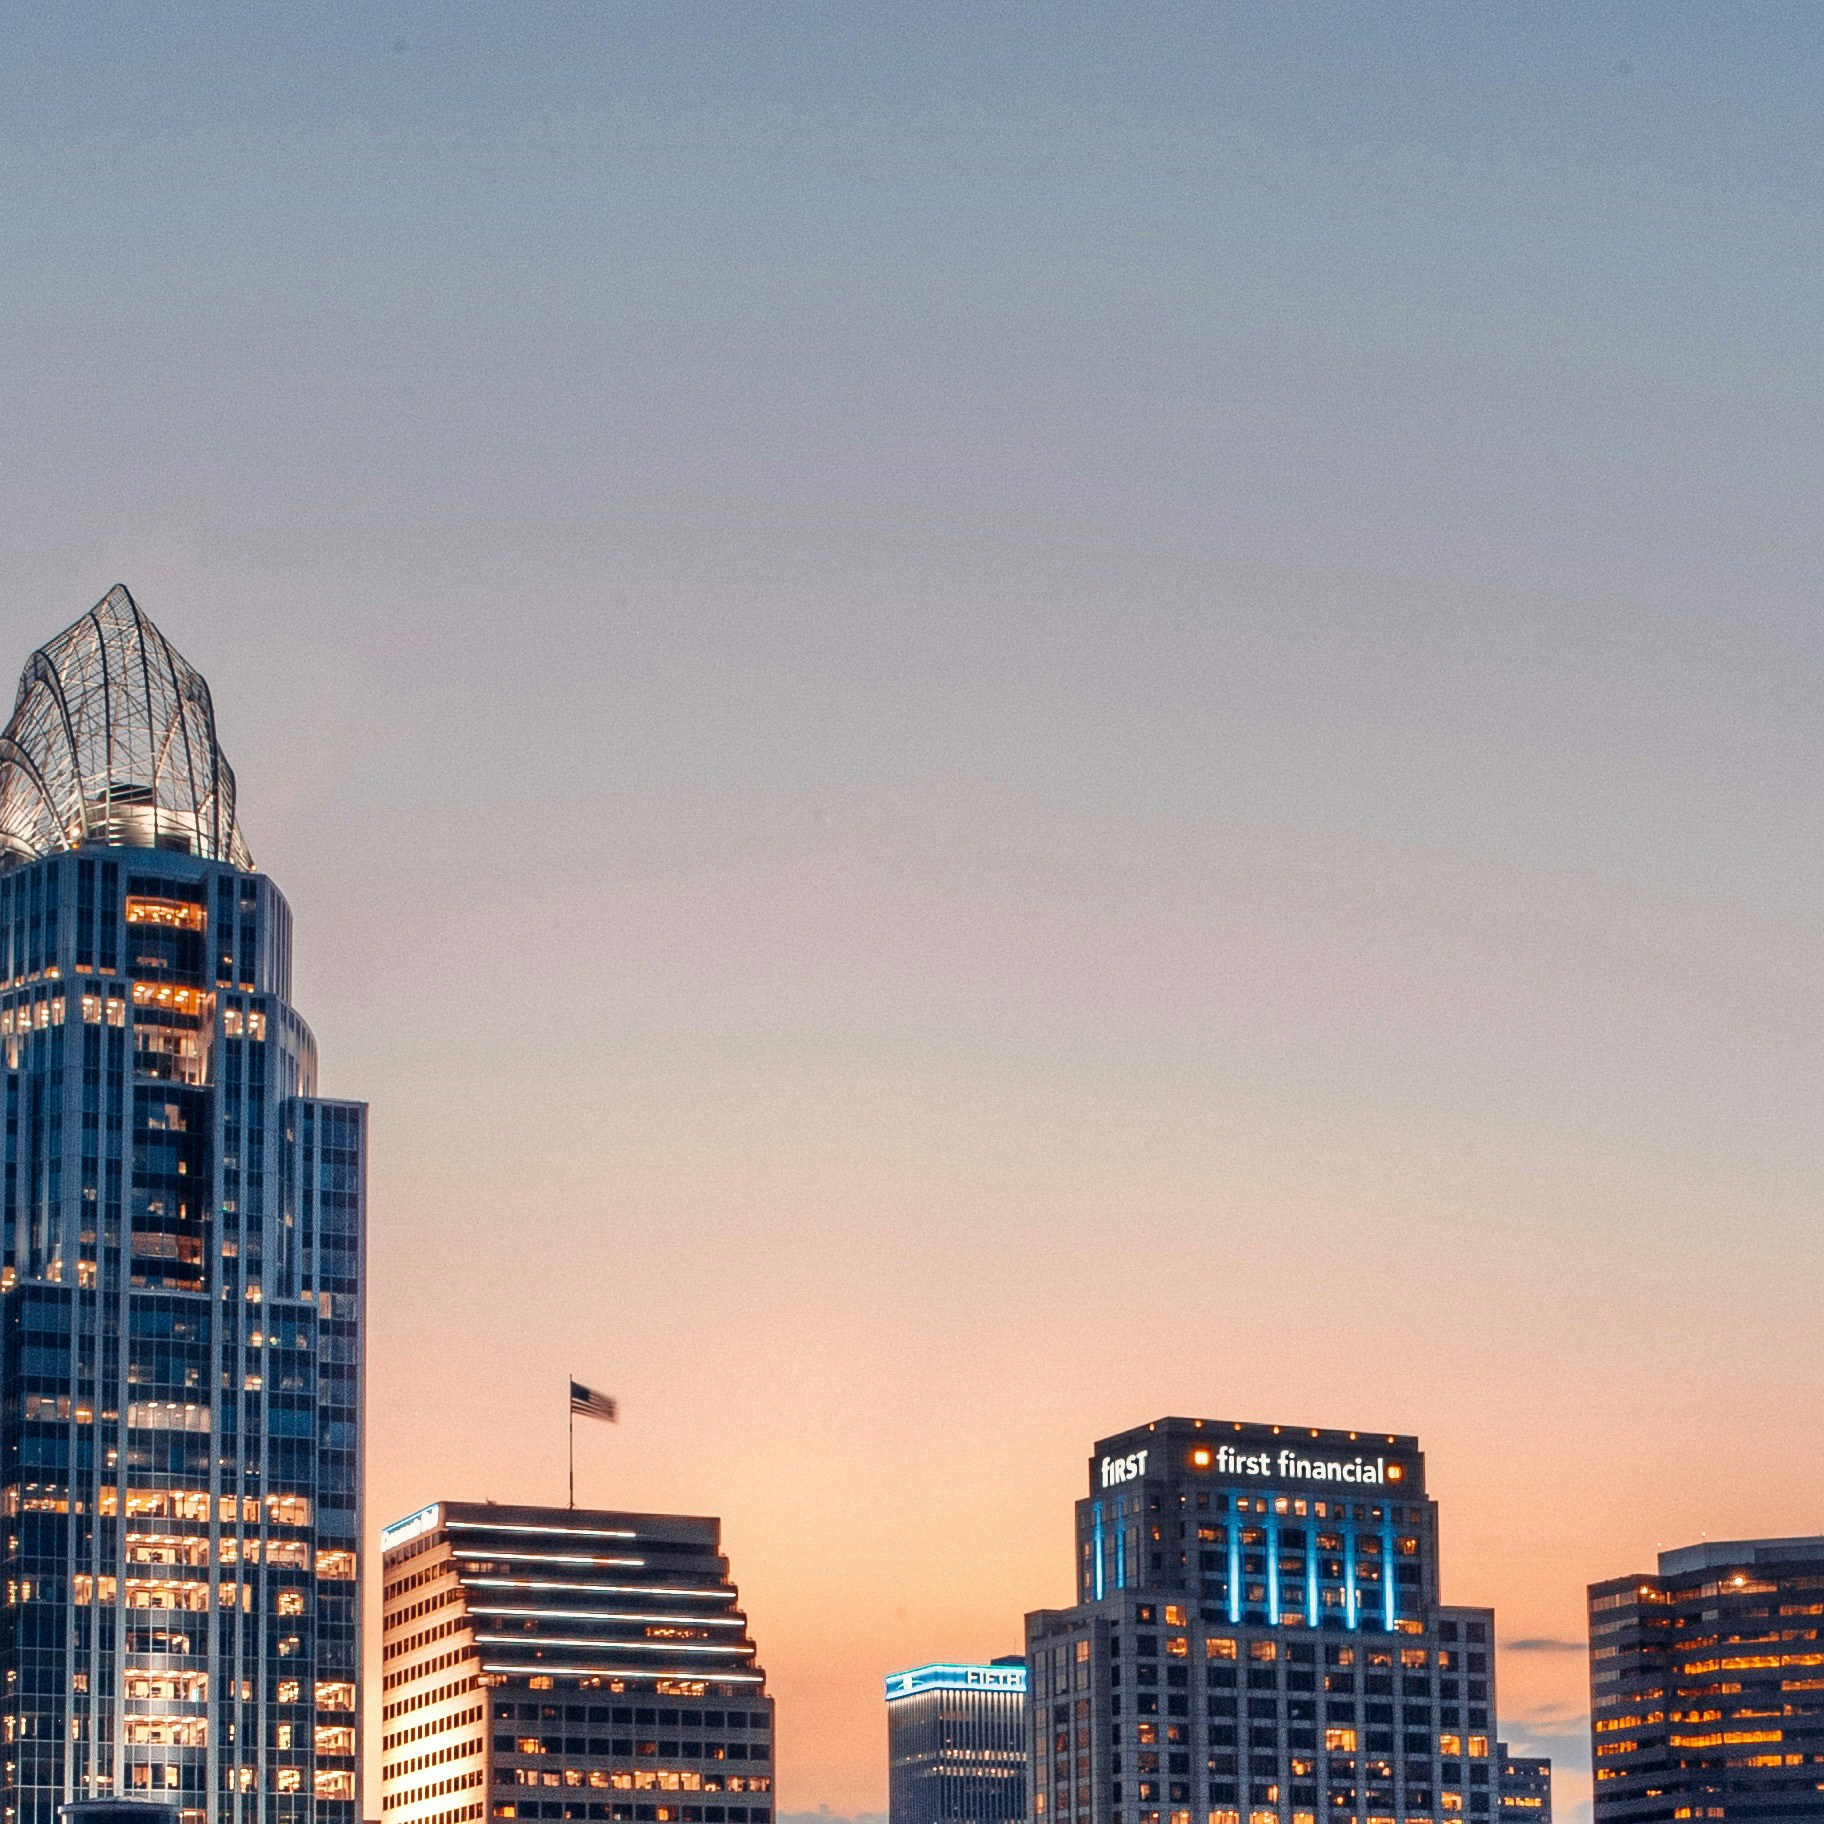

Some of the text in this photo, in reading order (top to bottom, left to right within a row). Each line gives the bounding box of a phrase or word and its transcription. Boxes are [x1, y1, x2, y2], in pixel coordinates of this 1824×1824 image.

[1216, 1445, 1384, 1484] first financial
[967, 1670, 1021, 1685] FIFTH
